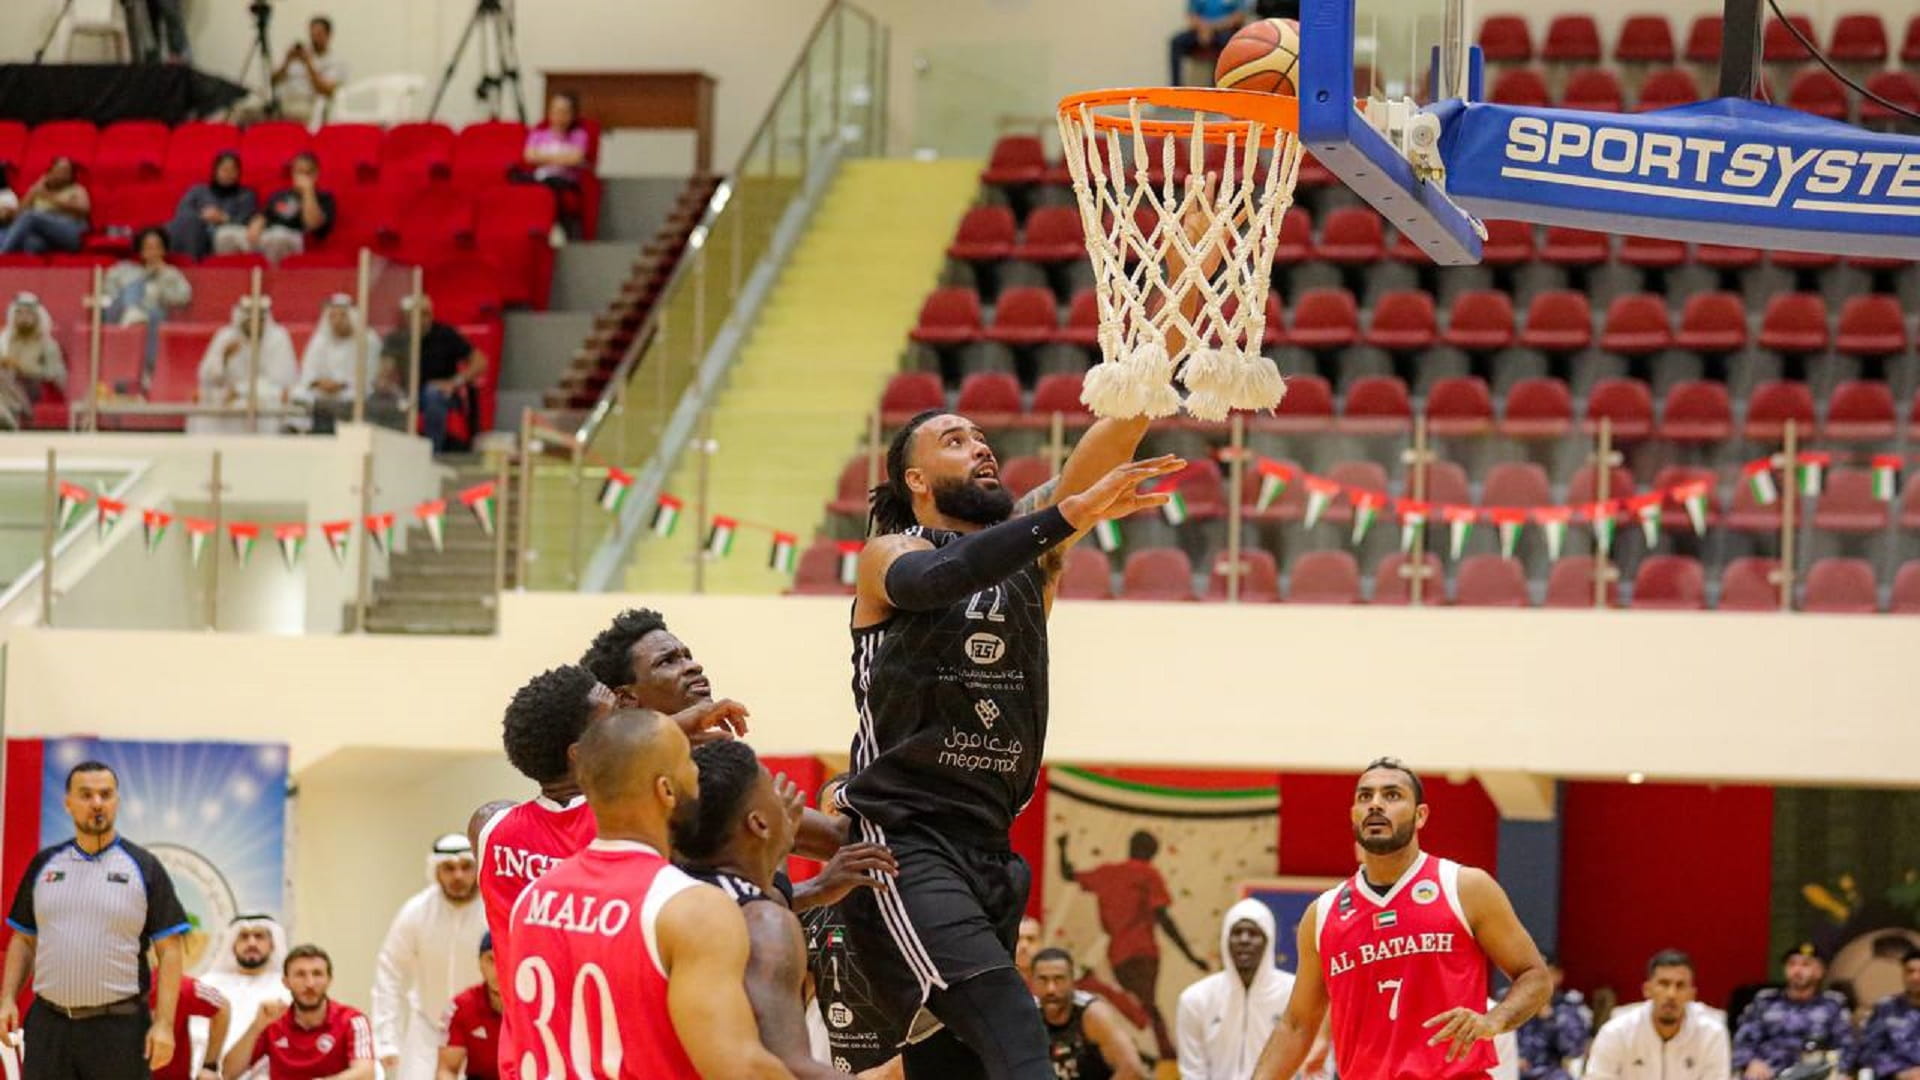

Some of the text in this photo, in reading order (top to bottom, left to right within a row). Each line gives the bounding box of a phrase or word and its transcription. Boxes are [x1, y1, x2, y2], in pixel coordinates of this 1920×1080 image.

[938, 750, 992, 772] mega
[523, 888, 630, 937] MALO
[1329, 933, 1454, 977] AL BATAEH
[514, 955, 624, 1080] 30
[1377, 977, 1404, 1021] 7
